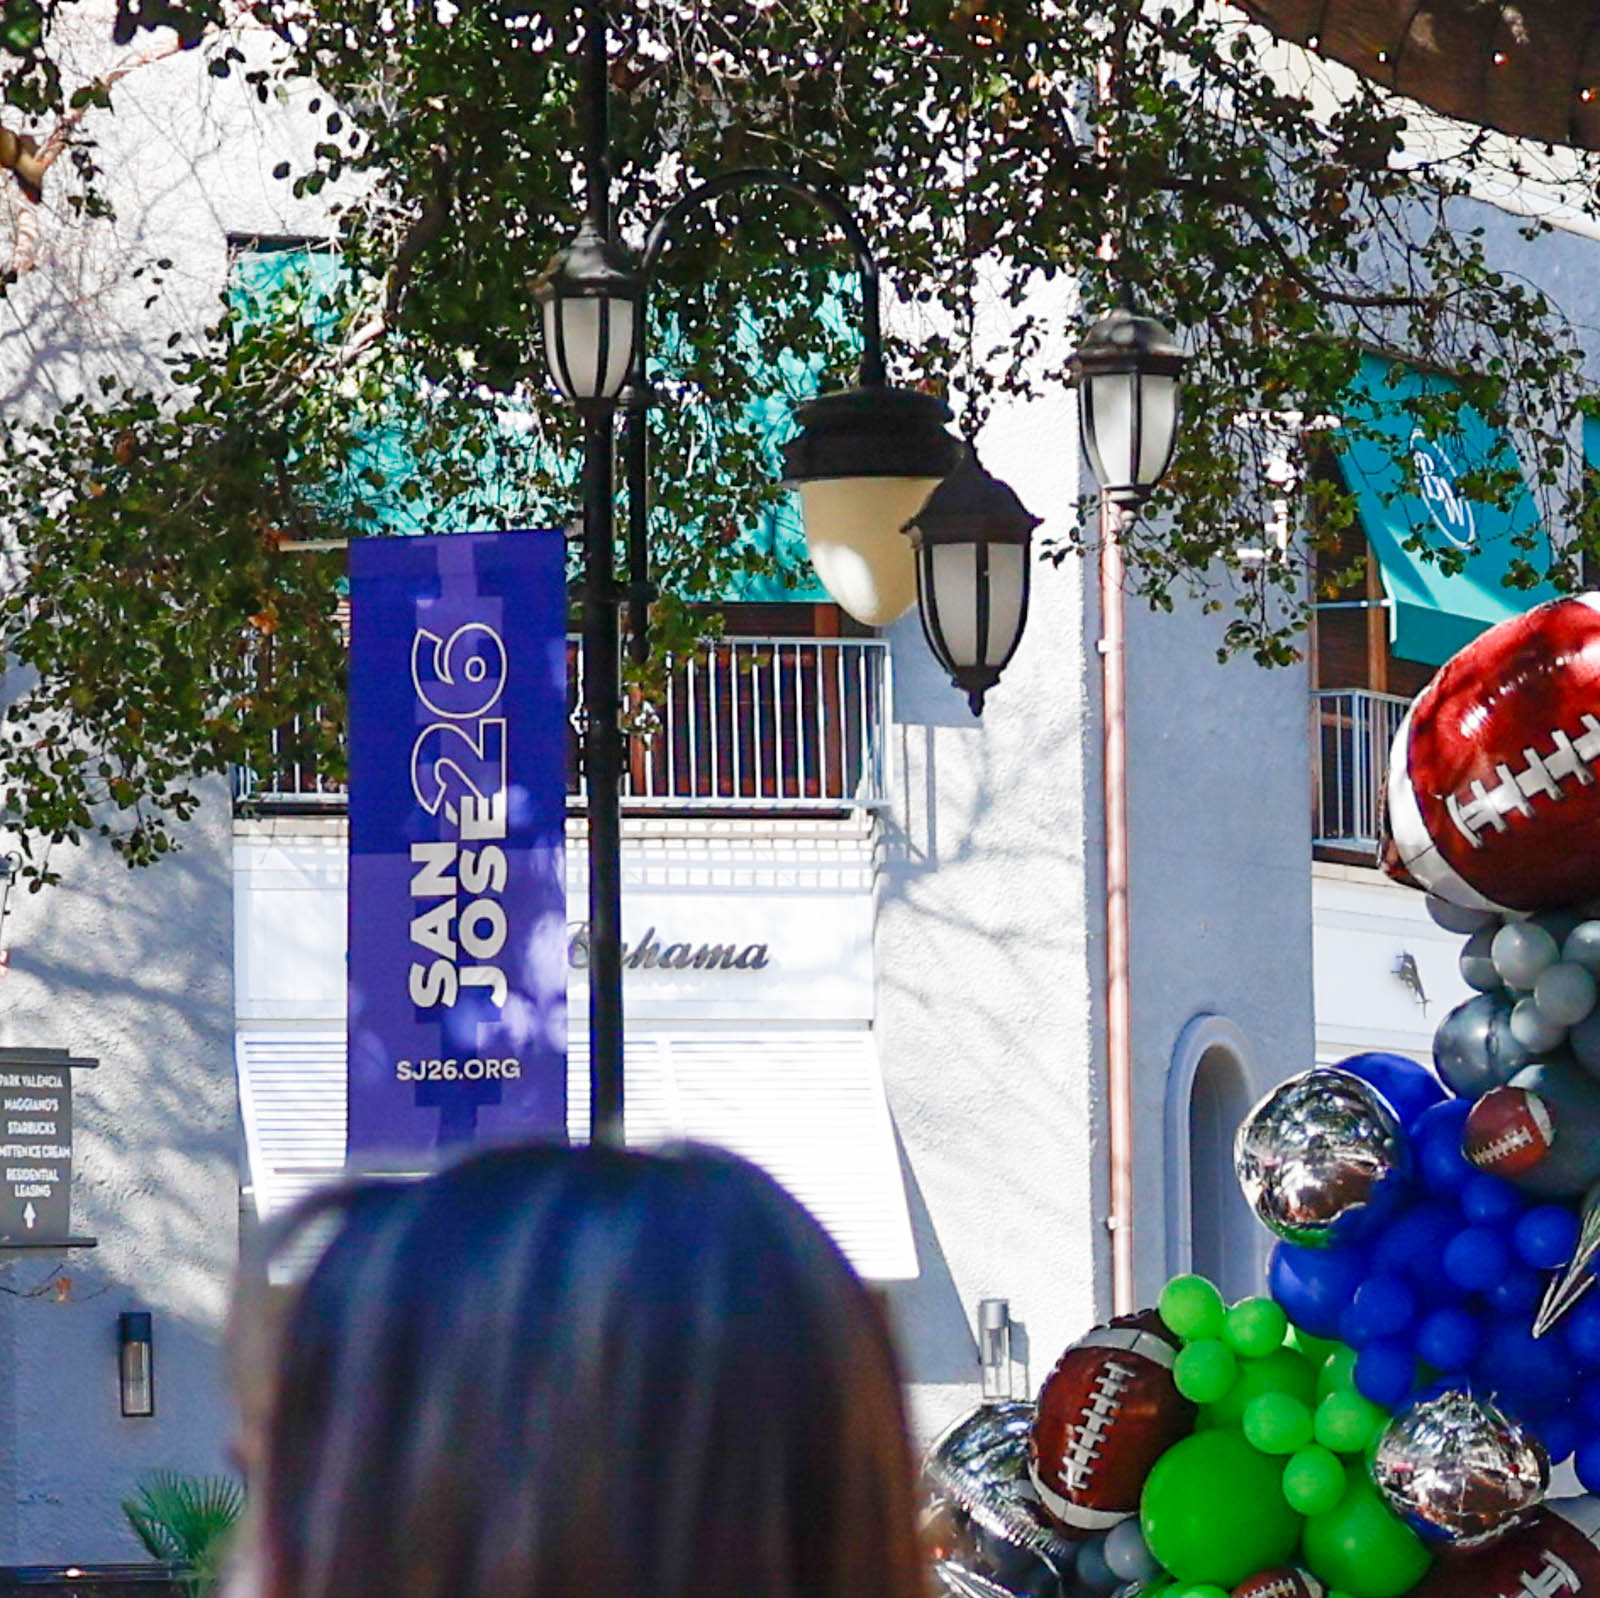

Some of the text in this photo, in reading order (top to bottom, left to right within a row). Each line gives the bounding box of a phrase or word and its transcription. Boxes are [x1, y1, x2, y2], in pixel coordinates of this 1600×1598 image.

[411, 622, 507, 816] 26
[409, 841, 459, 1008] SAN
[446, 794, 508, 1008] JOSÉ
[567, 920, 769, 970] Bhama
[396, 1058, 521, 1081] SJ26.ORG
